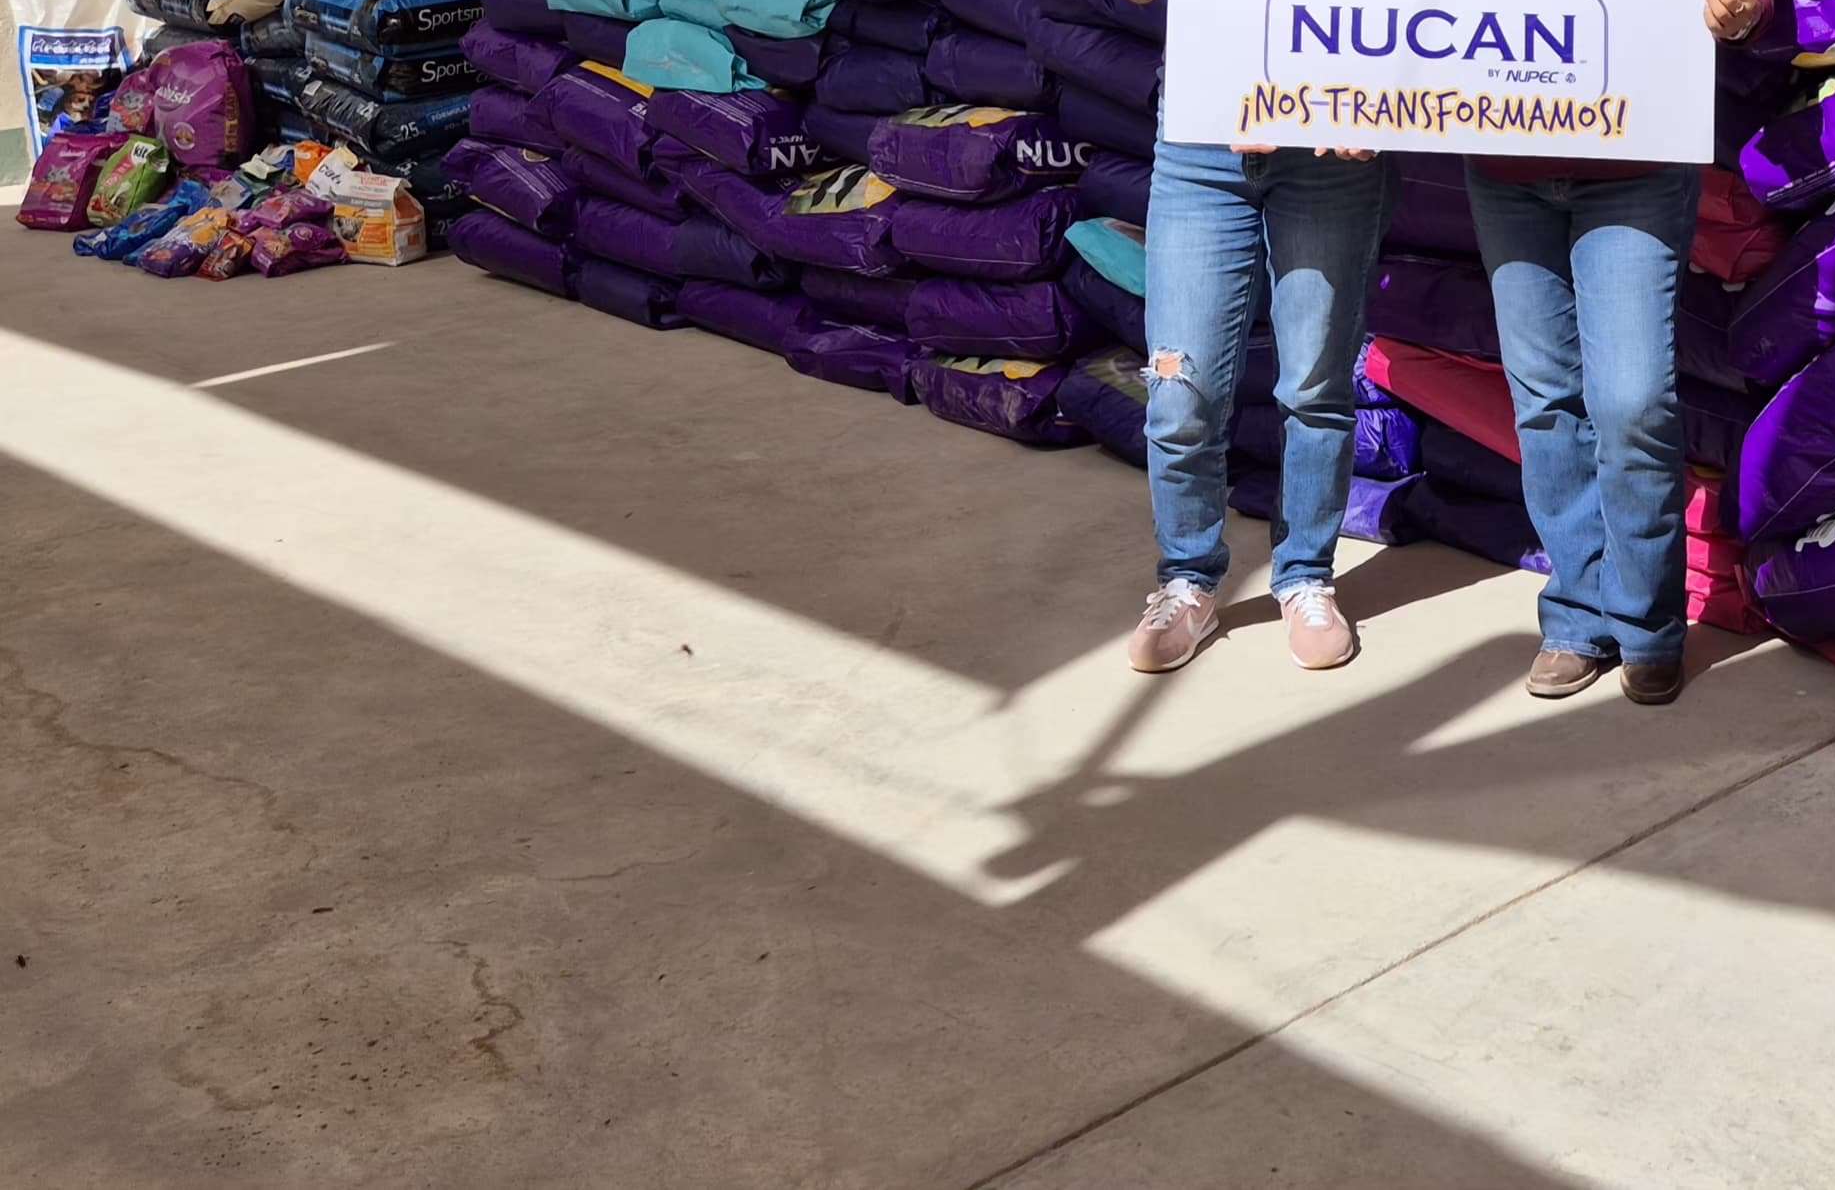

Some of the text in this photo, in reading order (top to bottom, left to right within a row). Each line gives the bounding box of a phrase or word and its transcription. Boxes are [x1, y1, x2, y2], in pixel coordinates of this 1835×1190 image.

[418, 6, 485, 34] Sportsm
[1290, 4, 1577, 64] NUCAN
[421, 60, 477, 82] Sports
[1488, 69, 1560, 84] BY NUPEC
[1240, 85, 1628, 138] ¡NOS TRANSFORMAMOS!
[1016, 139, 1092, 167] NUC
